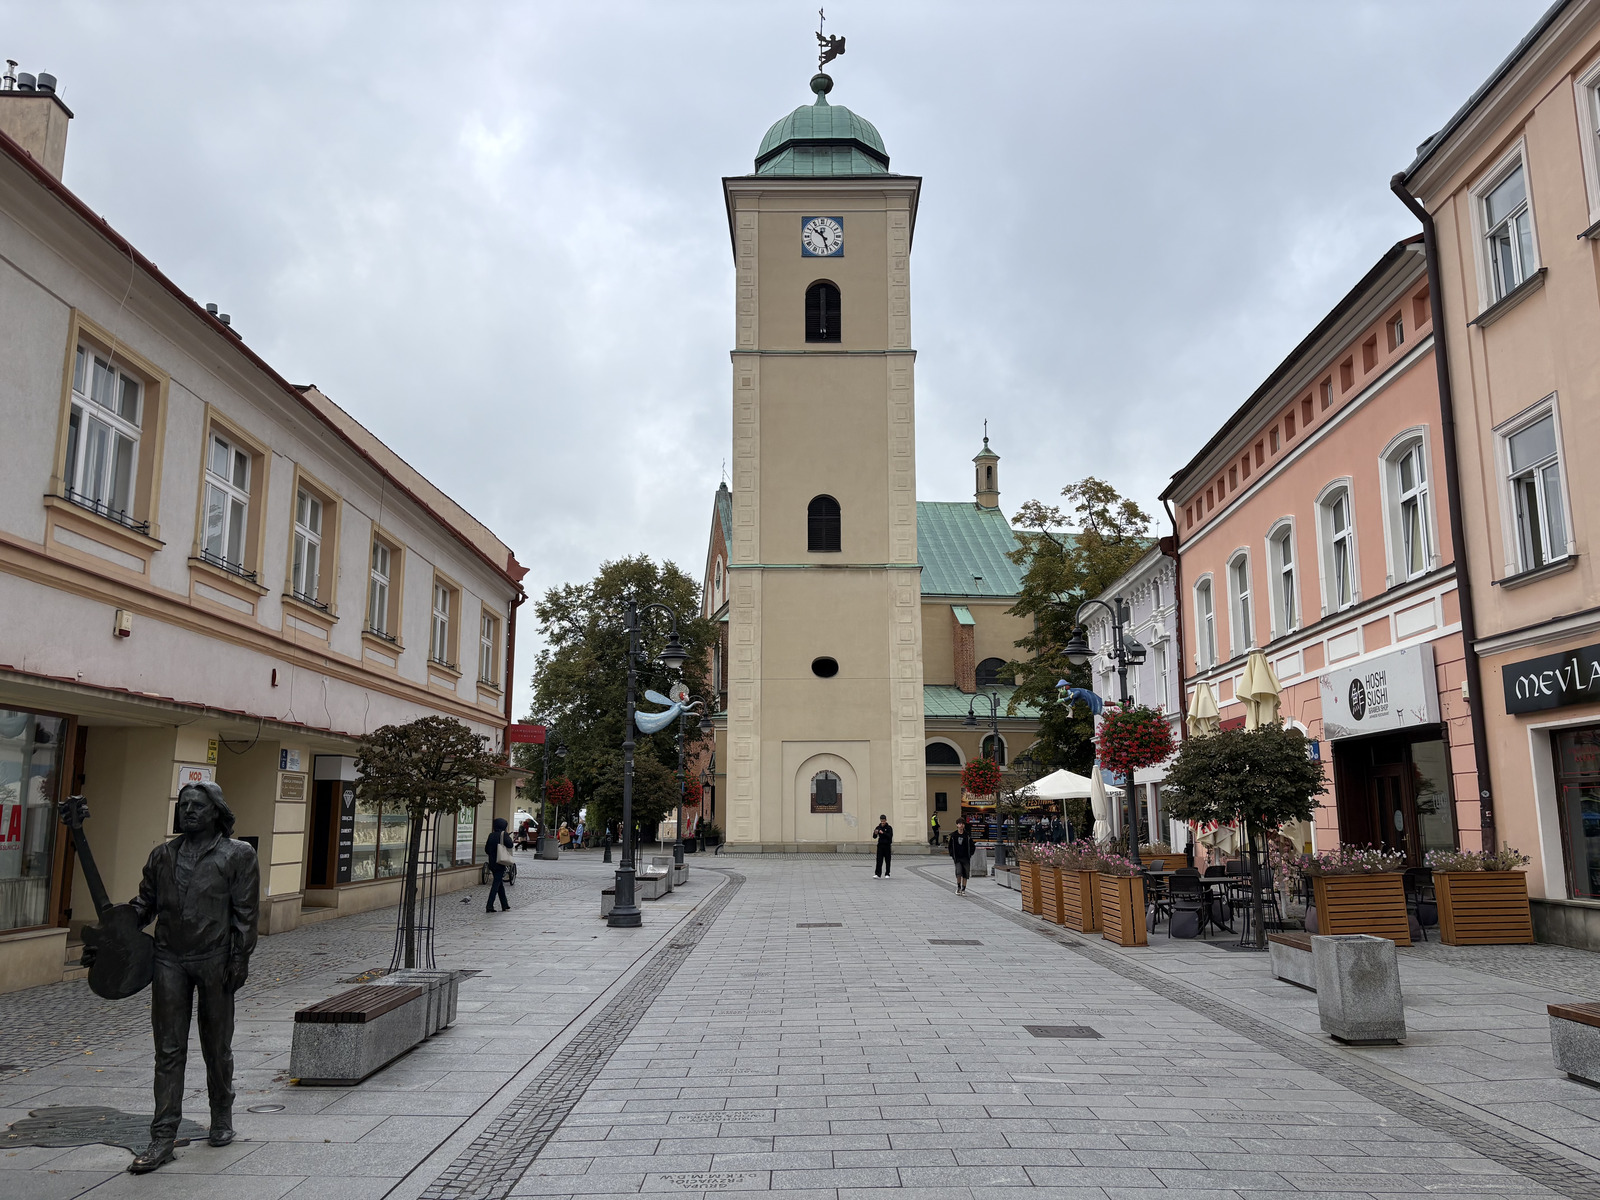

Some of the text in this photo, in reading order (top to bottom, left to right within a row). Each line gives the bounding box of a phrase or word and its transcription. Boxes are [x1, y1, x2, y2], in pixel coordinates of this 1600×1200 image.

[1365, 670, 1387, 690] HOSHI
[1367, 687, 1389, 707] SUSHI
[189, 771, 202, 781] KOD
